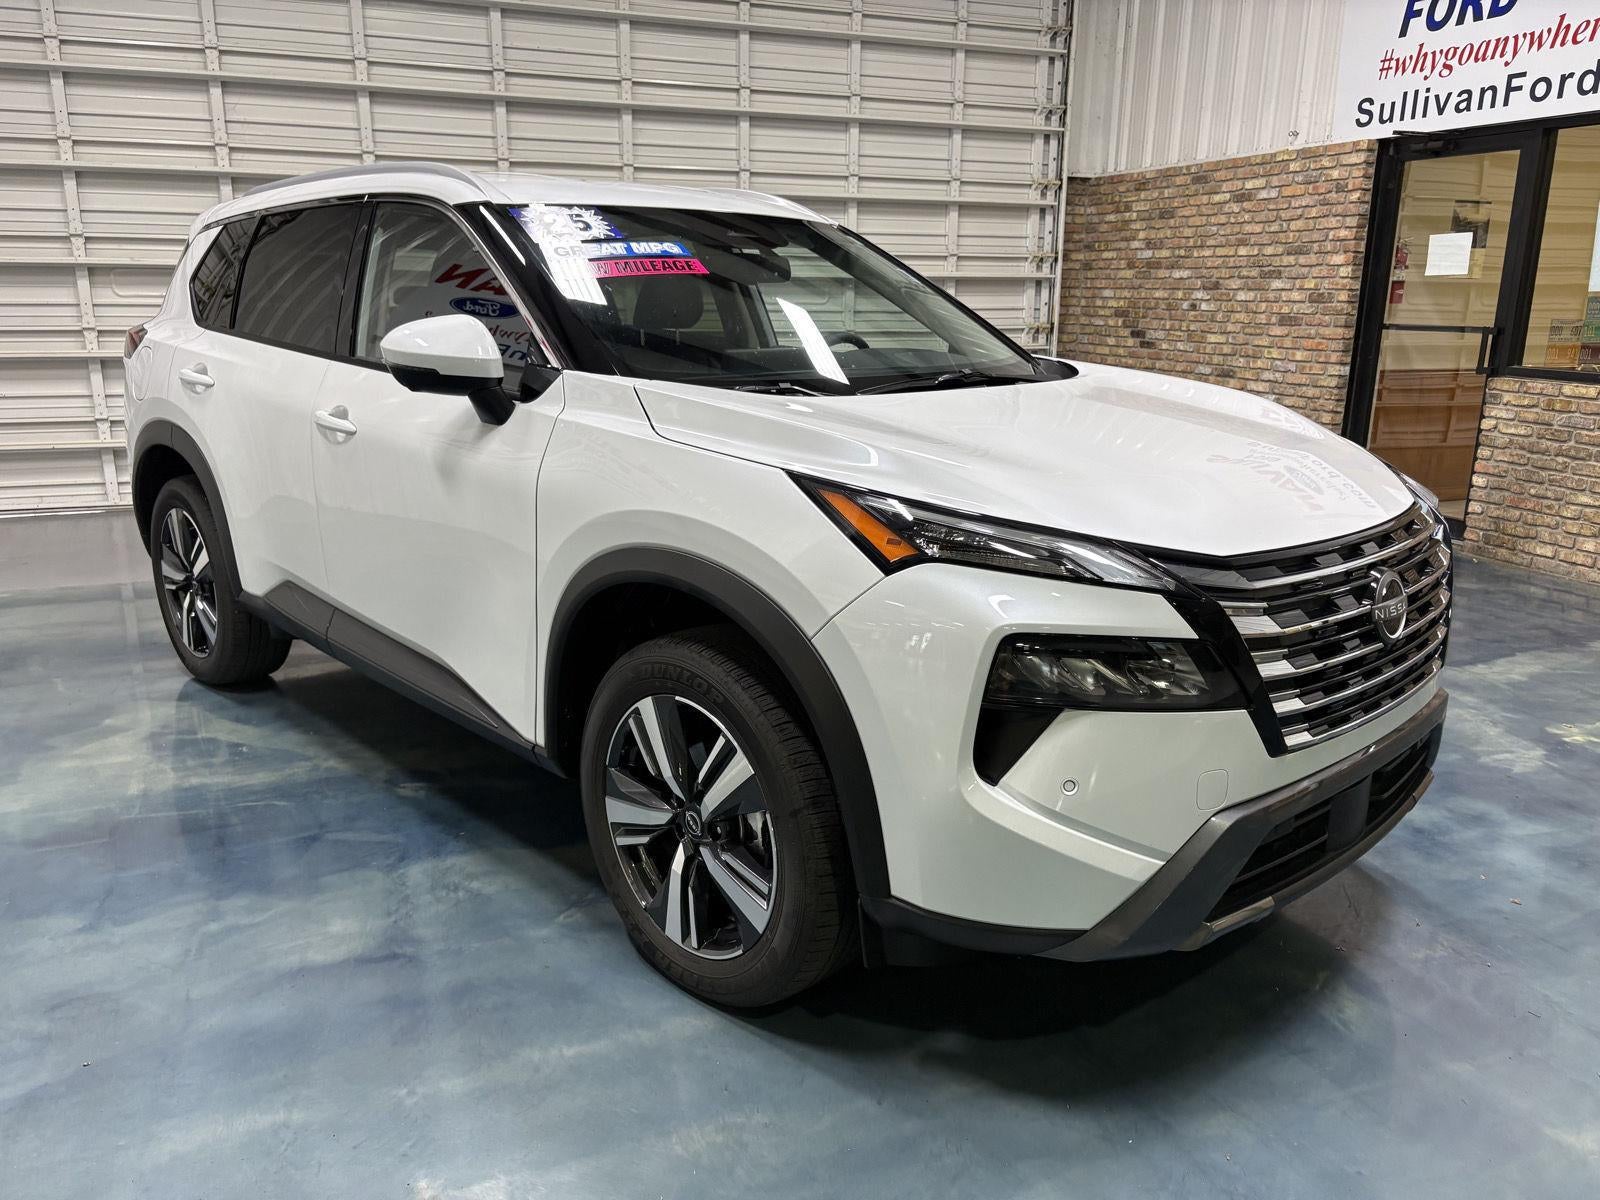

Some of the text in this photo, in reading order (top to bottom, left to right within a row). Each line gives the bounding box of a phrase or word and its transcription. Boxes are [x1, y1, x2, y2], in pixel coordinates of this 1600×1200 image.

[1355, 58, 1600, 128] SullivanFord
[553, 241, 683, 256] GREAT MPG
[615, 260, 696, 274] MILEAGE
[1375, 602, 1406, 620] NISS
